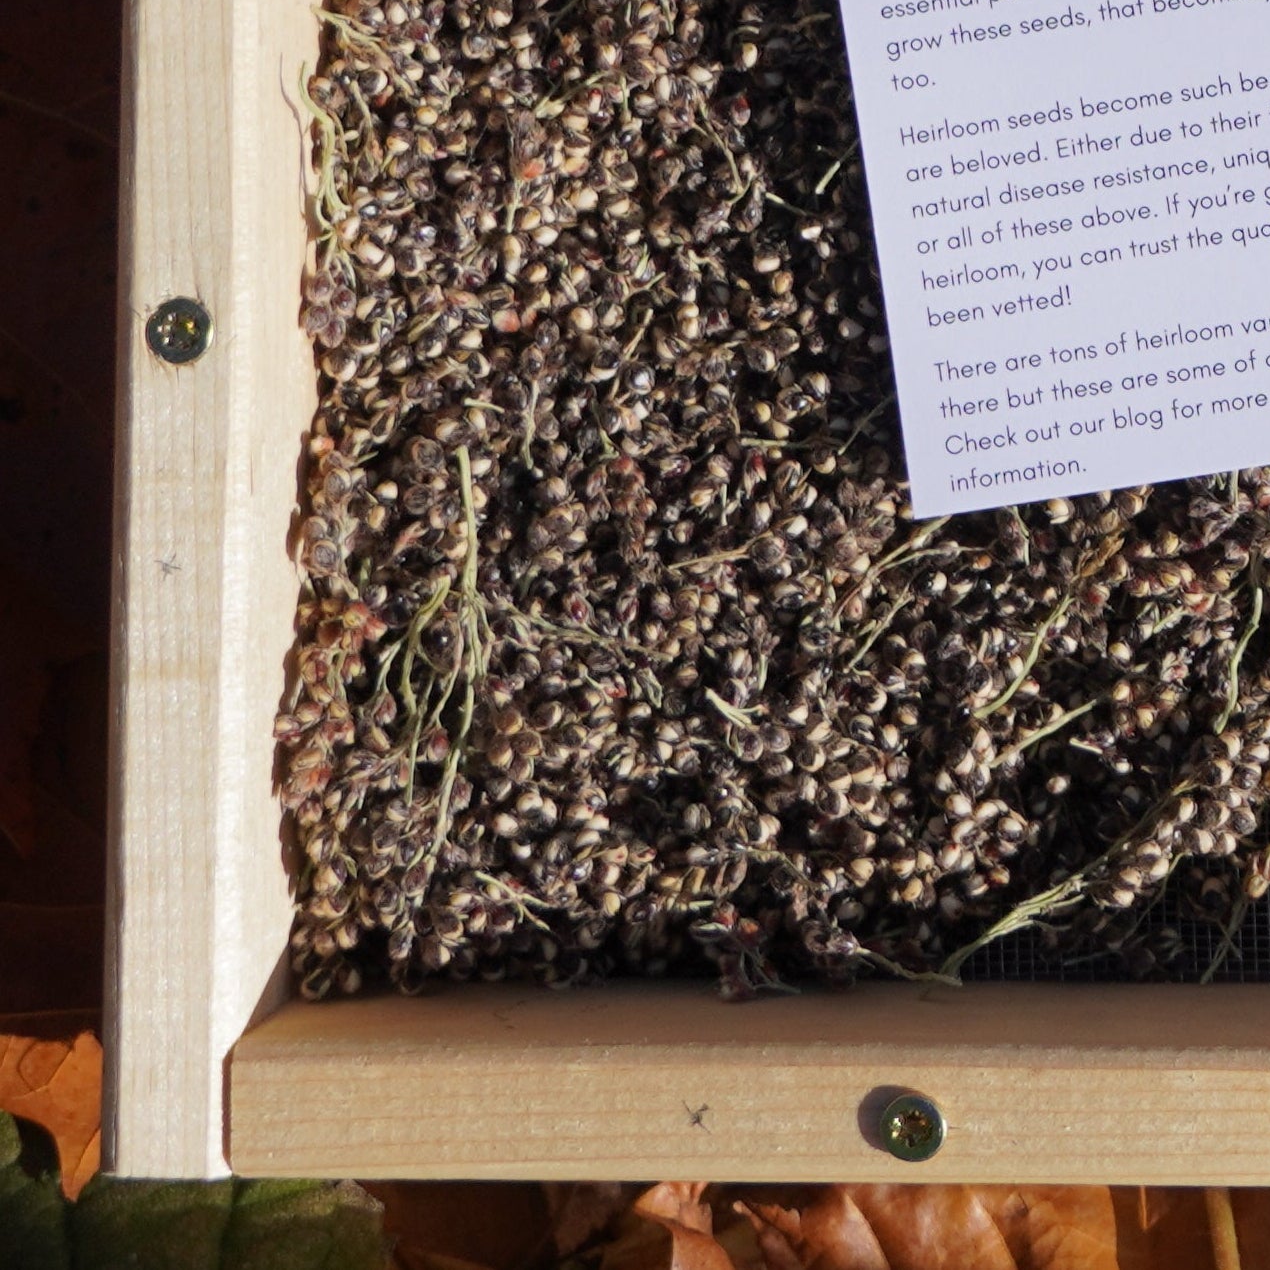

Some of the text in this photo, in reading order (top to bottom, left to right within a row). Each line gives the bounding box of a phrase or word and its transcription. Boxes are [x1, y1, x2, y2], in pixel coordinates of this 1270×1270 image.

[890, 73, 936, 92] too.
[899, 118, 1000, 147] Heirloom
[1007, 100, 1074, 130] seeds
[1079, 91, 1173, 118] become
[1180, 74, 1232, 102] such
[926, 284, 1072, 328] been vetted!
[933, 359, 997, 383] There
[1005, 354, 1042, 372] are
[1049, 345, 1098, 365] tons
[1104, 331, 1128, 356] of
[1135, 323, 1234, 351] heirloom
[950, 459, 1087, 493] information.
